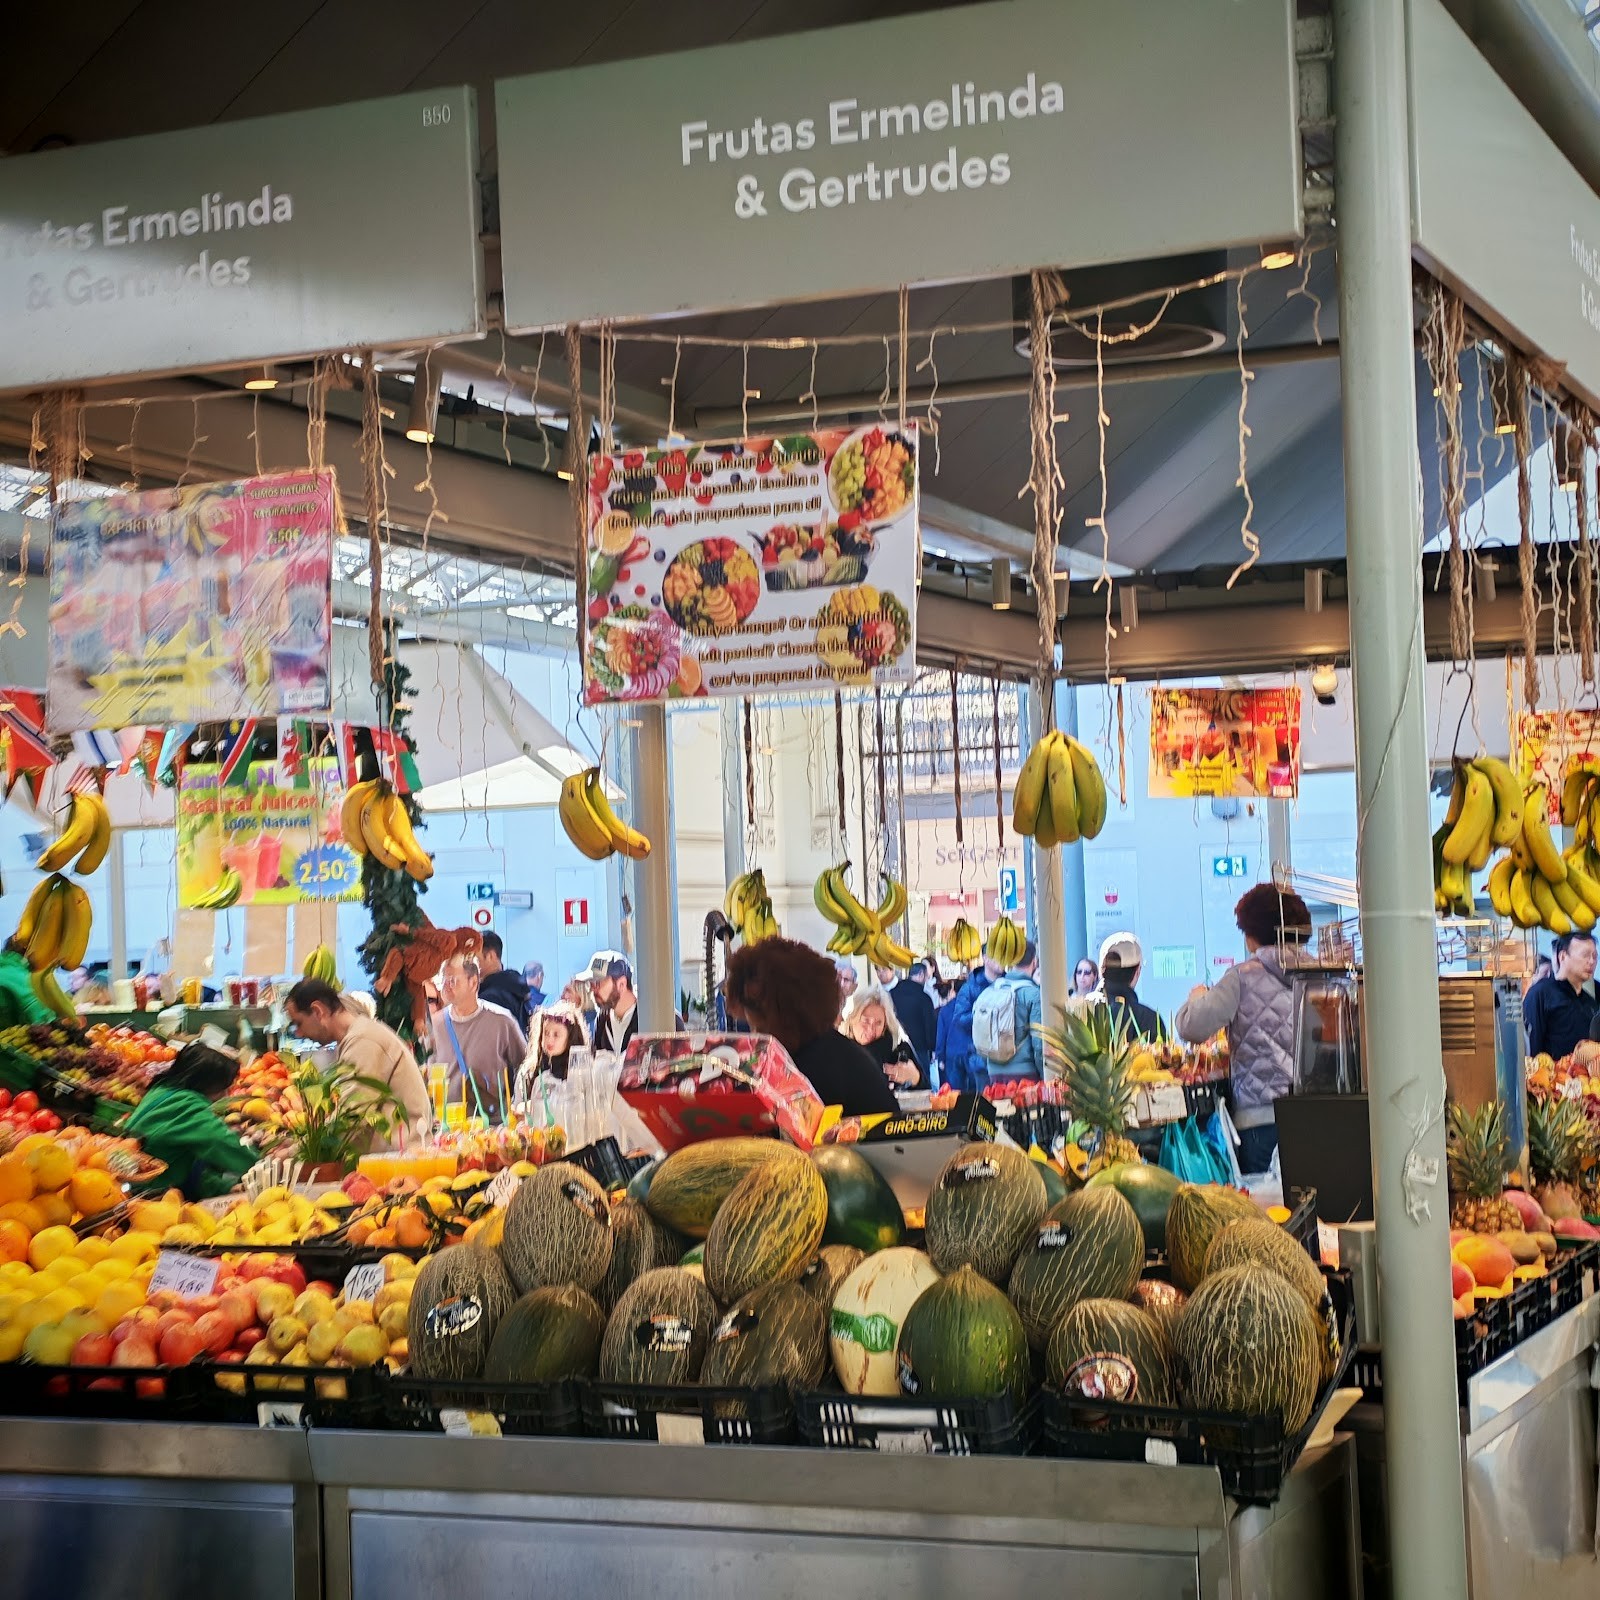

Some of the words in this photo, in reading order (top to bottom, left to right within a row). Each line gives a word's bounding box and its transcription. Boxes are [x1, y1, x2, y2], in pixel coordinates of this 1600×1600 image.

[681, 119, 816, 166] Frutas
[829, 72, 1064, 145] Ermelinda
[735, 174, 768, 219] &
[779, 146, 1011, 212] Gertrudes
[102, 184, 293, 247] Ermelinda
[26, 272, 52, 312] &
[63, 249, 250, 305] Gertrudes
[259, 793, 317, 812] Juices
[262, 813, 312, 828] Natural
[1003, 871, 1013, 898] P
